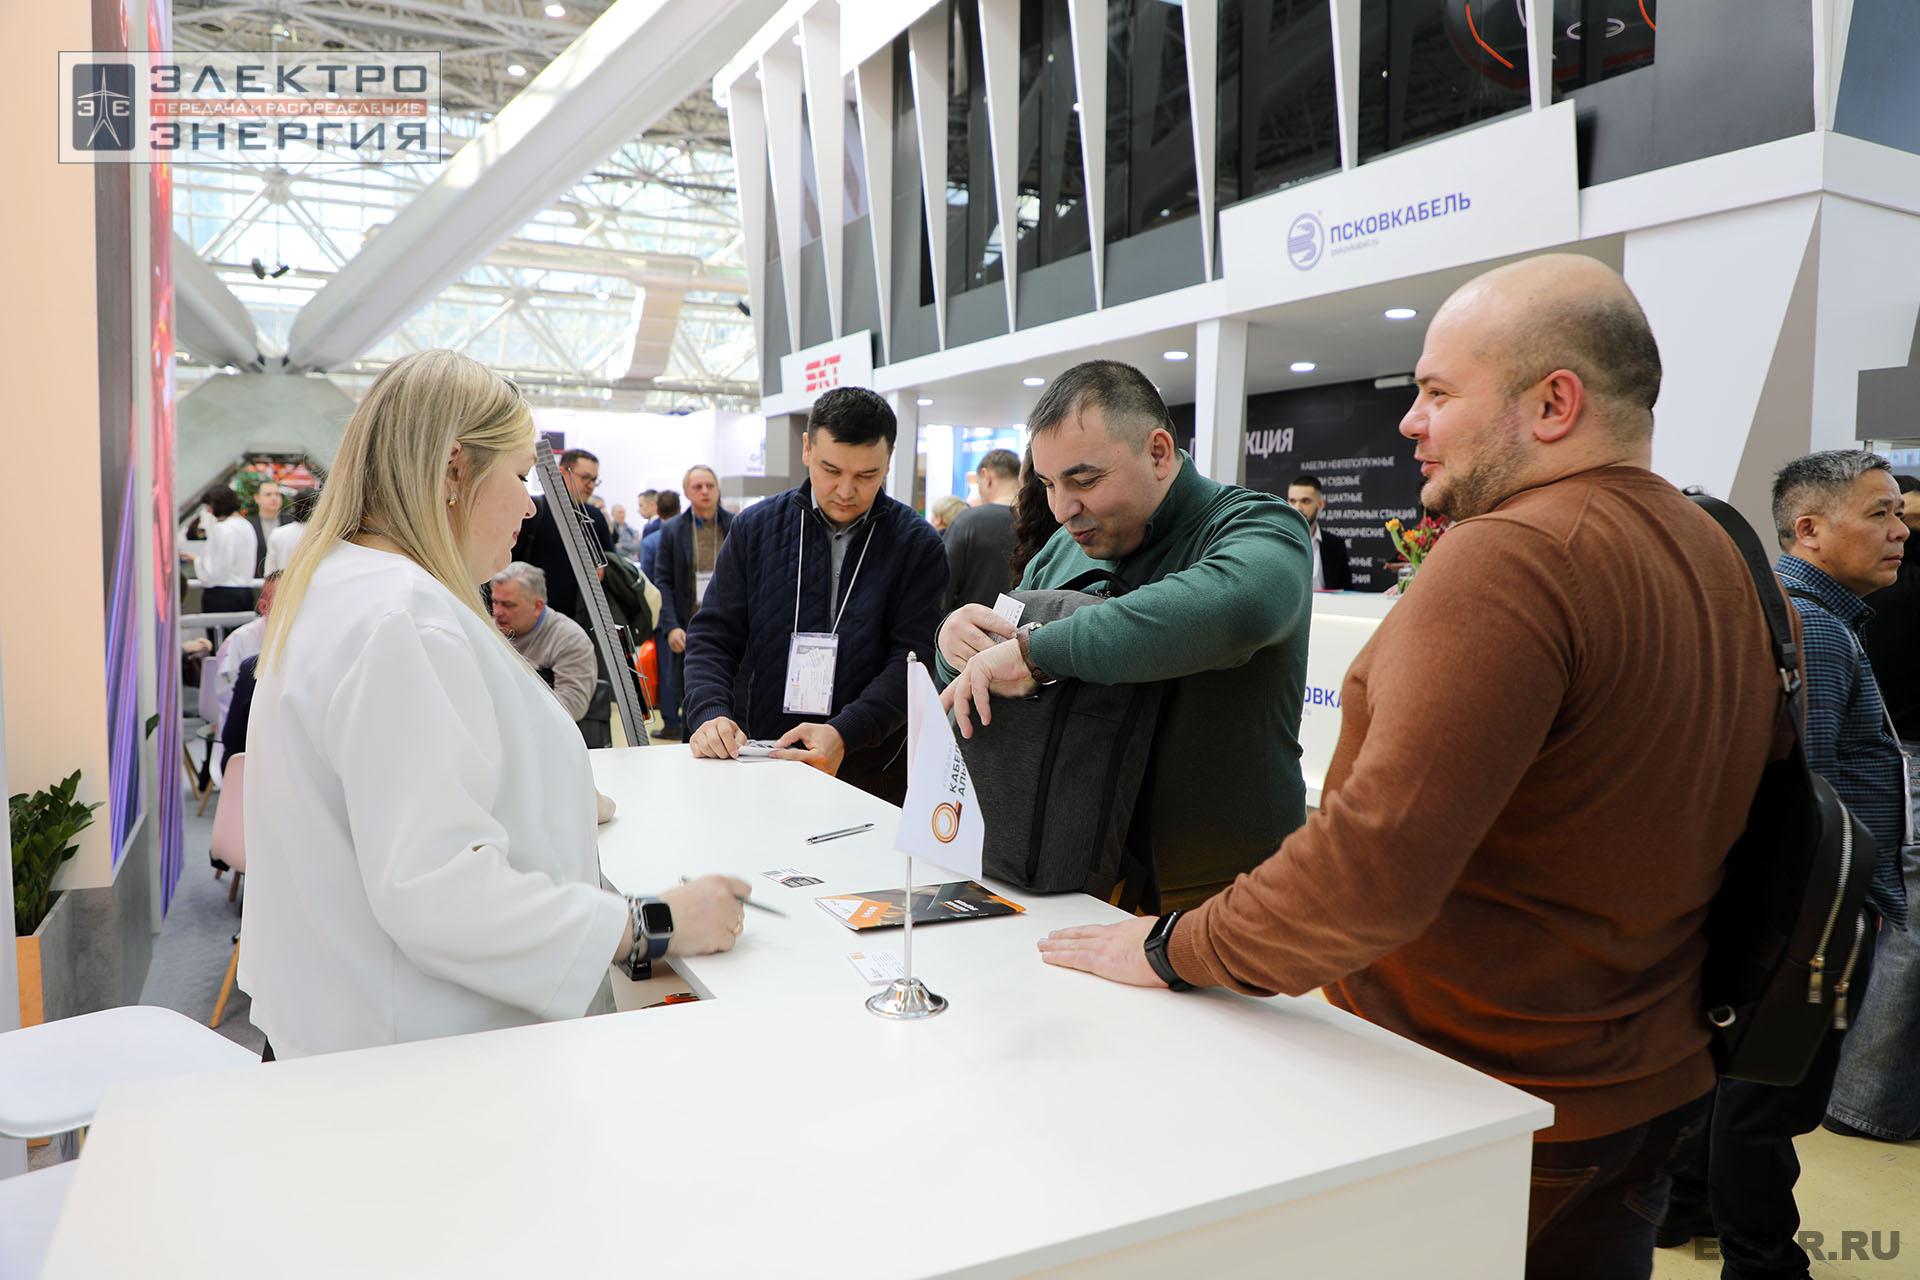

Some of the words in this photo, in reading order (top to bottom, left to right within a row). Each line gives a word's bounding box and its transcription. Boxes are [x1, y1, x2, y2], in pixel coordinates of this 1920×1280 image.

[1330, 191, 1471, 244] ПСКОВКАБЕЛЬ
[1245, 427, 1294, 459] КЦИЯ
[949, 743, 961, 793] КАБЕЛ
